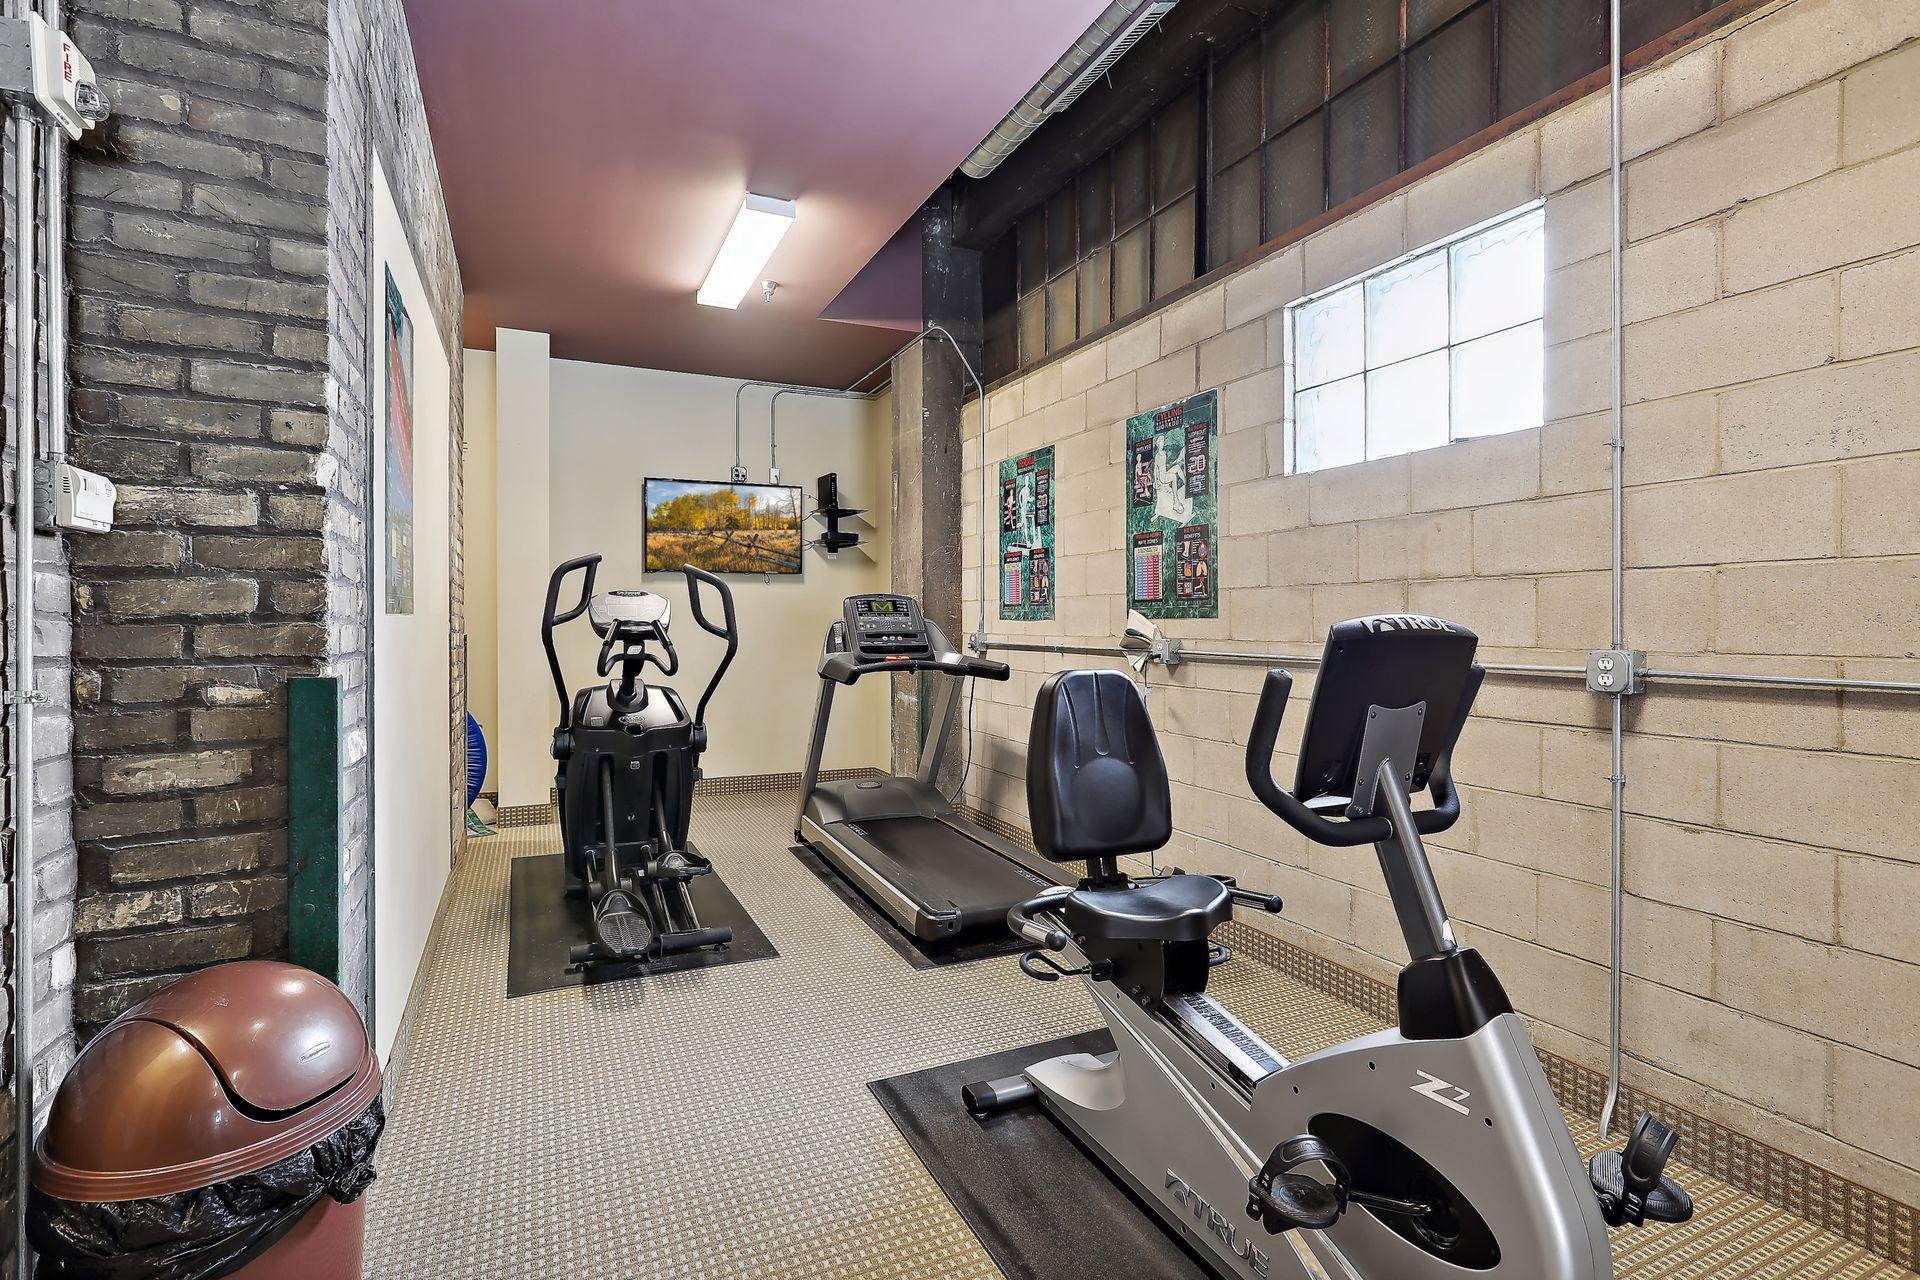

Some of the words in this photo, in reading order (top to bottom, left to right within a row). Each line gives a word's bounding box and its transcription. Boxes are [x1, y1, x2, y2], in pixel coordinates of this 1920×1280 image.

[63, 42, 72, 83] FIRE
[1156, 407, 1182, 422] CYCLING
[1156, 419, 1183, 432] WORKOUT
[1386, 616, 1456, 633] TRUE
[1190, 1187, 1270, 1278] TRUE
